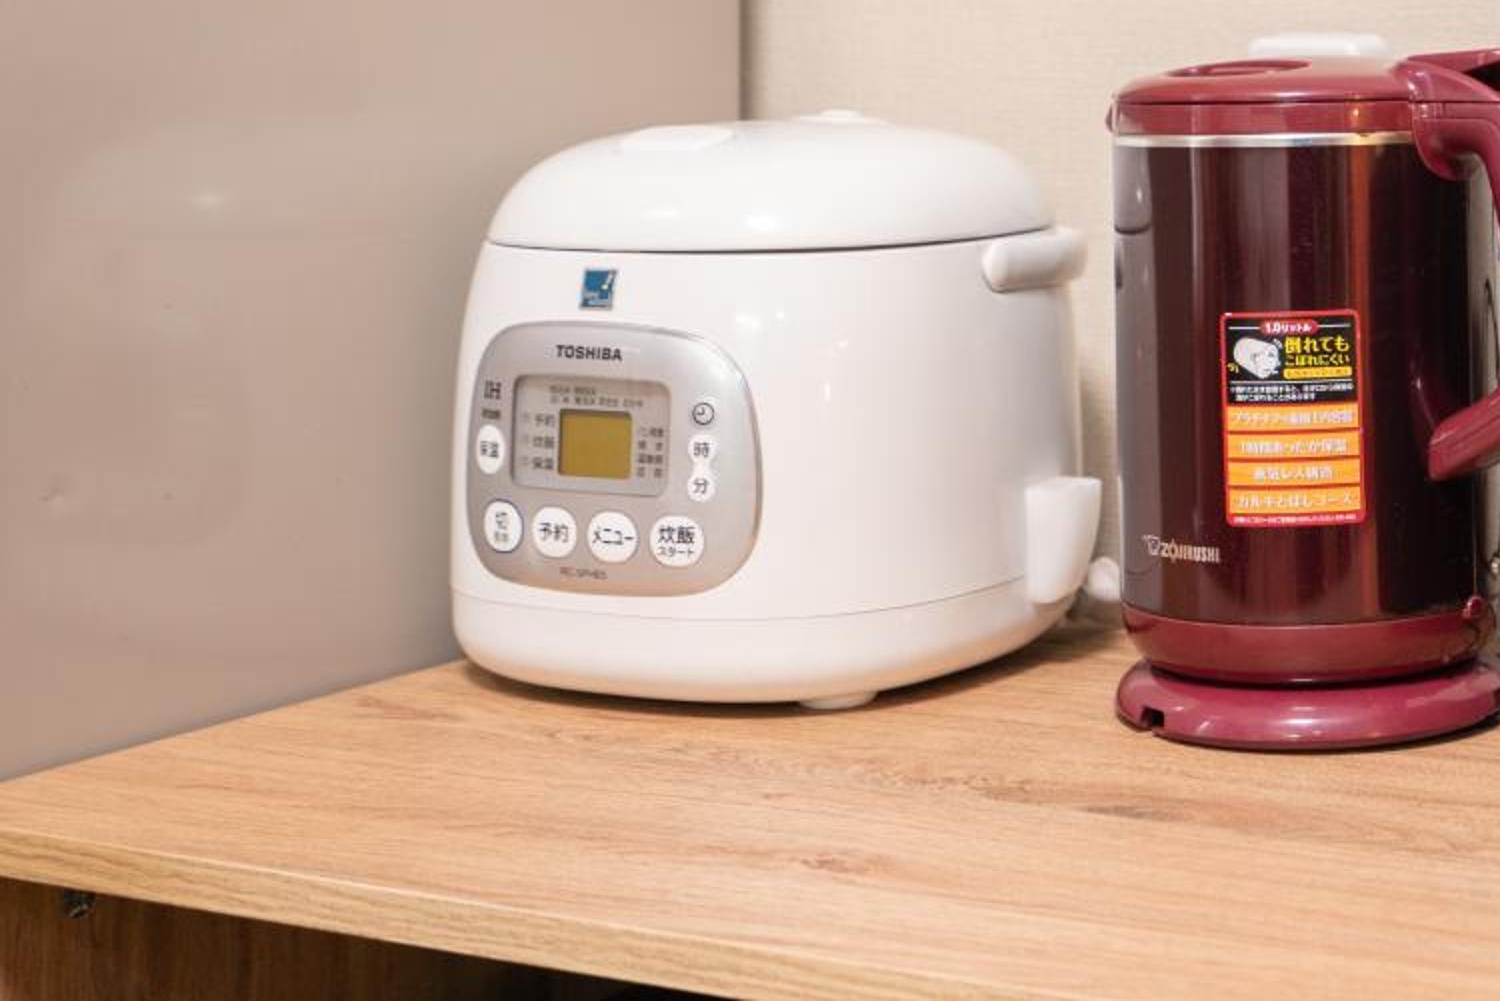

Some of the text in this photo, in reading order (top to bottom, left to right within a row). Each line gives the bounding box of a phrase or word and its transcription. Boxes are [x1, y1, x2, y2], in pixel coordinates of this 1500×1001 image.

[556, 345, 622, 361] TOSHIBA
[1285, 336, 1350, 354] 倒れても
[1285, 354, 1350, 366] こぼれにくい
[693, 441, 709, 458] 時
[693, 478, 708, 494] 分
[539, 522, 568, 544] 予約
[592, 526, 634, 545] メニュー
[658, 525, 695, 545] 炊飯
[658, 546, 695, 557] スタート
